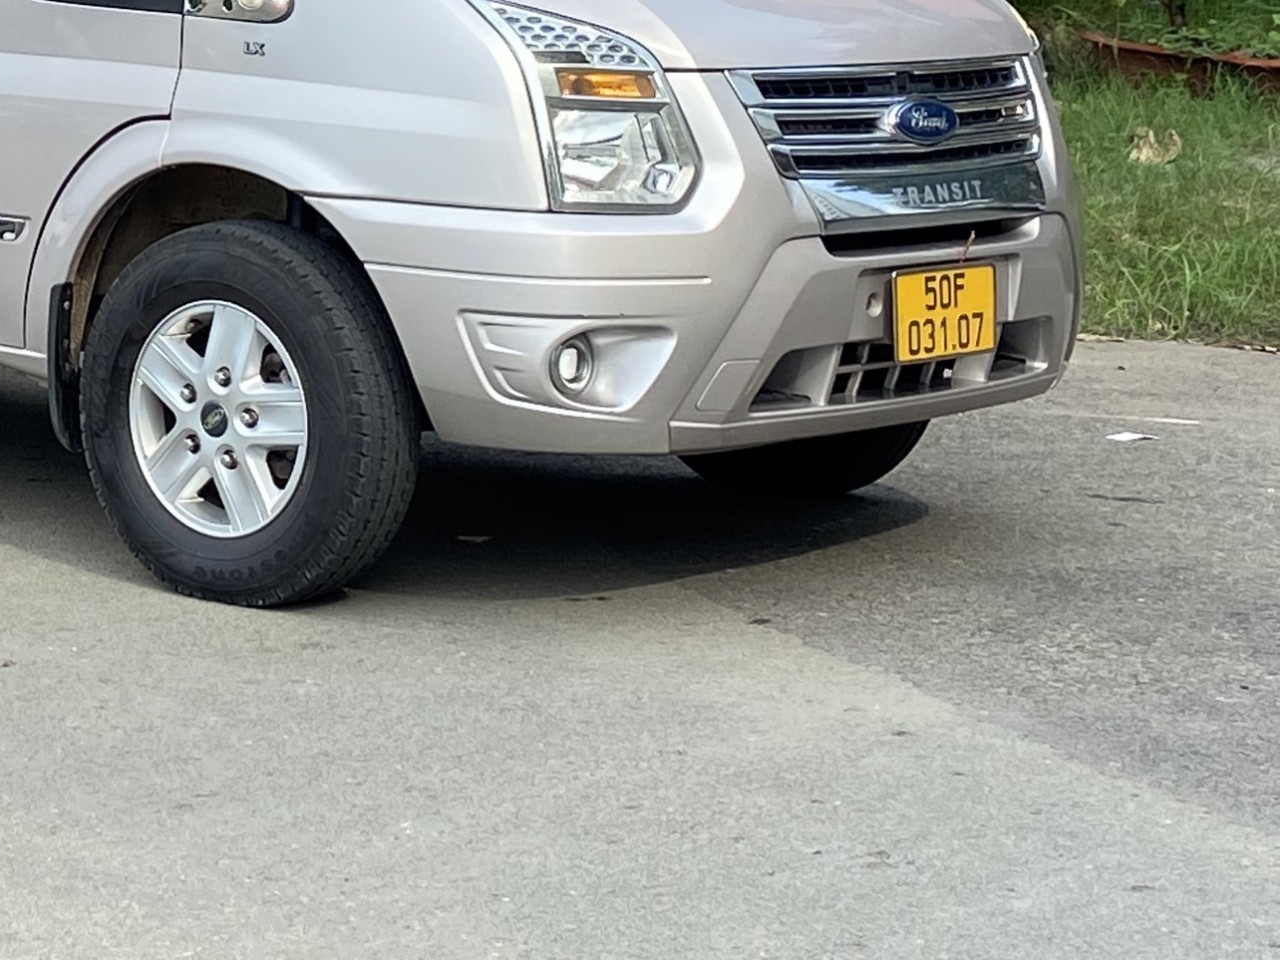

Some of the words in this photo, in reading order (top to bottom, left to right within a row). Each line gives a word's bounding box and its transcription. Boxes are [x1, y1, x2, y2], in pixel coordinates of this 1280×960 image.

[243, 42, 265, 56] LX
[892, 180, 983, 206] TRANSIT
[924, 272, 966, 311] 50F
[908, 312, 984, 356] 031.07
